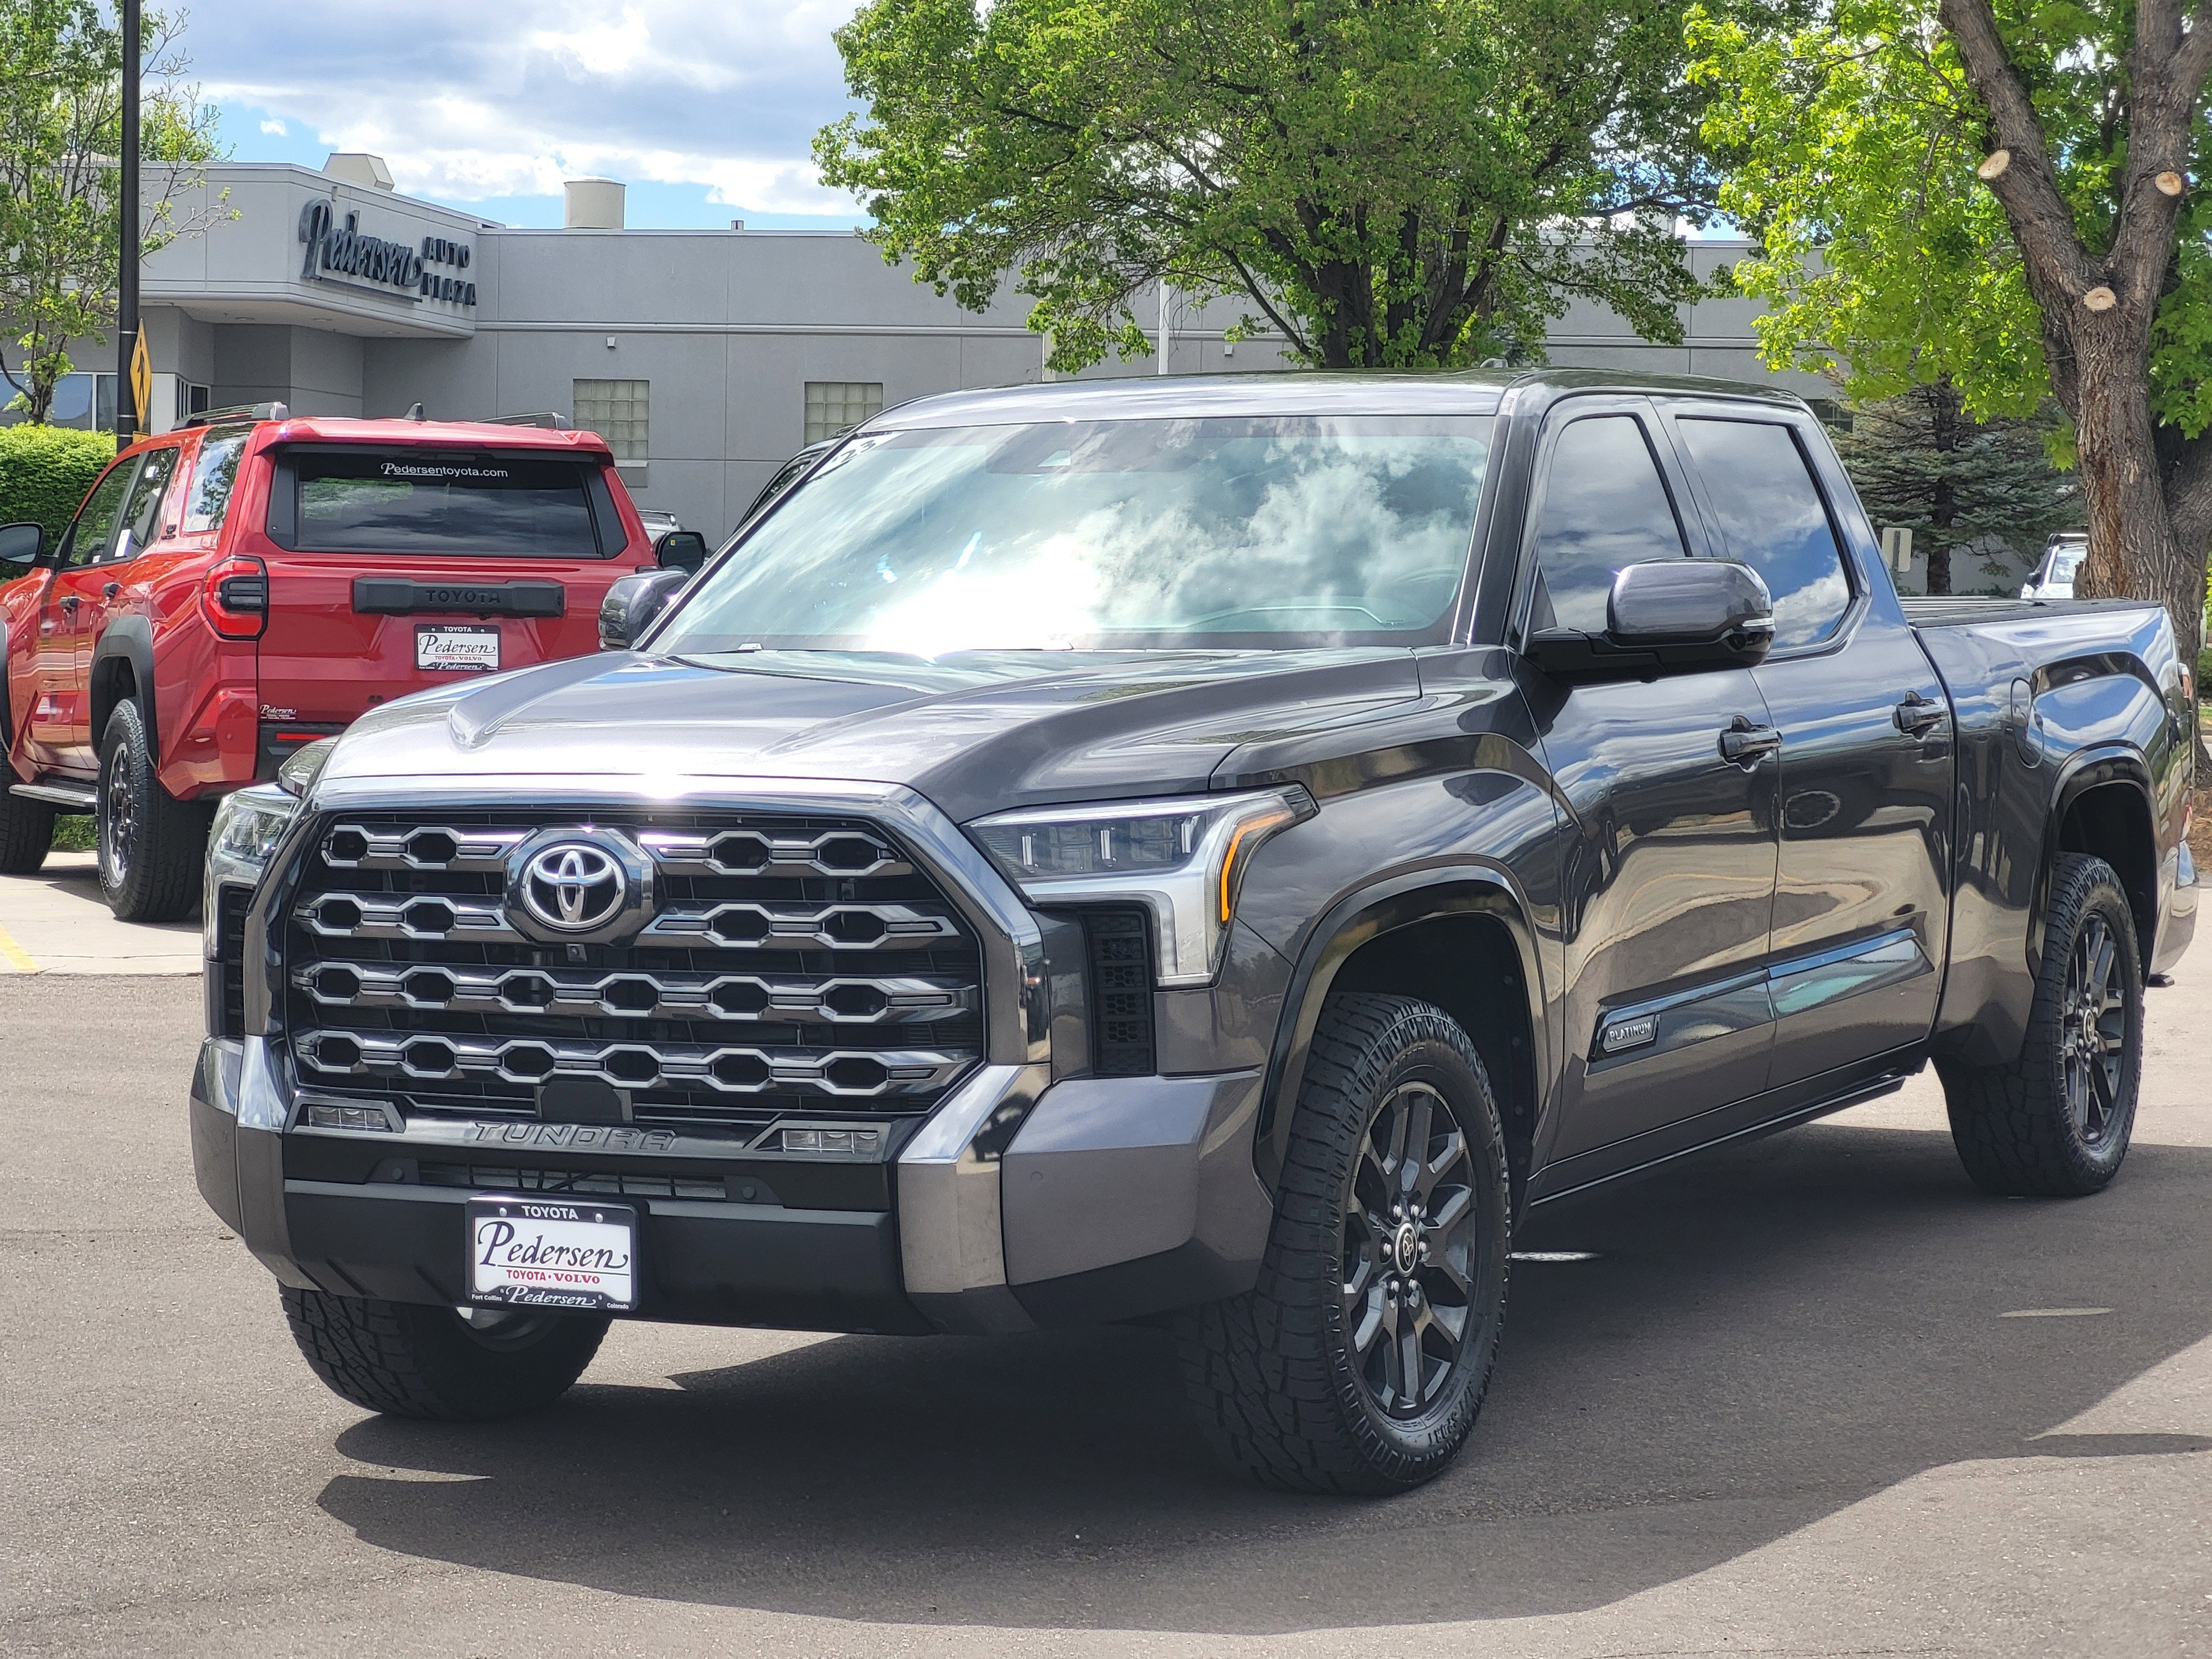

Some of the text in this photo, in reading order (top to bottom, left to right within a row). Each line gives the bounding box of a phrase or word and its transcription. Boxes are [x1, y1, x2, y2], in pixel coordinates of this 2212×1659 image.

[299, 198, 424, 287] Pedersen
[422, 236, 470, 268] AUTO
[420, 272, 477, 306] PLAZA
[380, 462, 508, 477] Pedersentoyota.com
[426, 589, 501, 604] TOYOTA
[419, 634, 497, 655] Pedersen
[436, 662, 483, 670] Pedersen
[1609, 1021, 1652, 1042] PLATINUM
[474, 1121, 676, 1151] TUNDRA
[521, 1205, 579, 1220] TOYOTA
[477, 1220, 629, 1269] Pedersen
[506, 1269, 601, 1285] TOYOTA VOLVO
[505, 1285, 596, 1306] Pedersen
